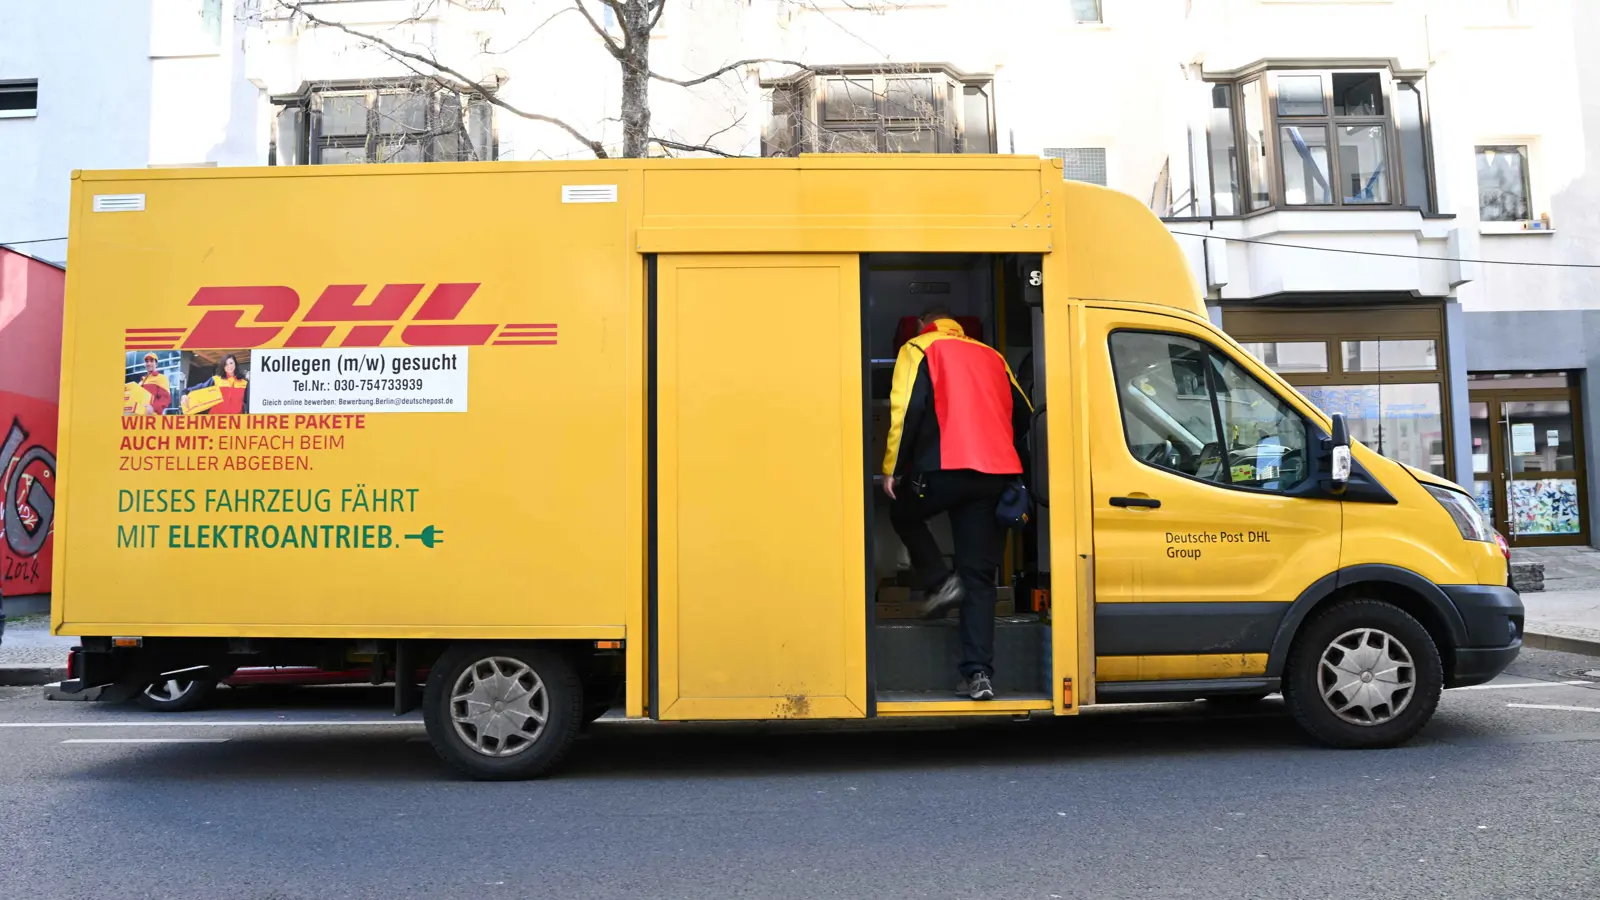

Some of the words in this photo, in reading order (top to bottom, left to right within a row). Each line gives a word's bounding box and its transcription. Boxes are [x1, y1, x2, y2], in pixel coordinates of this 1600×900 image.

[181, 283, 499, 348] DHL
[262, 356, 330, 375] Kollegen
[338, 354, 385, 375] (m/w)
[392, 354, 456, 374] gesucht
[293, 379, 330, 392] Tel.Nr.:
[335, 379, 422, 391] 030-754733939
[262, 398, 281, 407] Gleich
[284, 398, 302, 406] online
[304, 398, 337, 406] bewerben:
[339, 396, 454, 407] Bewerbung.Berlin@deutschepost.de
[122, 416, 156, 430] WIR
[162, 415, 240, 429] NEHMEN
[247, 415, 289, 429] IHRE
[295, 415, 365, 429] PAKETE
[120, 436, 169, 450] AUCH
[176, 436, 213, 450] MIT:
[219, 435, 293, 450] EINFACH
[301, 435, 344, 449] BEIM
[120, 456, 218, 470] ZUSTELLER
[223, 456, 312, 470] ABGEBEN.
[119, 489, 195, 512] DIESES
[206, 489, 330, 512] FAHRZEUG
[342, 484, 419, 512] FÄHRT
[118, 525, 160, 548] MIT
[169, 525, 399, 548] ELEKTROANTRIEB.
[1166, 531, 1218, 543] Deutsche
[1221, 532, 1245, 542] Post
[1248, 531, 1270, 542] DHL
[1167, 547, 1201, 560] Group
